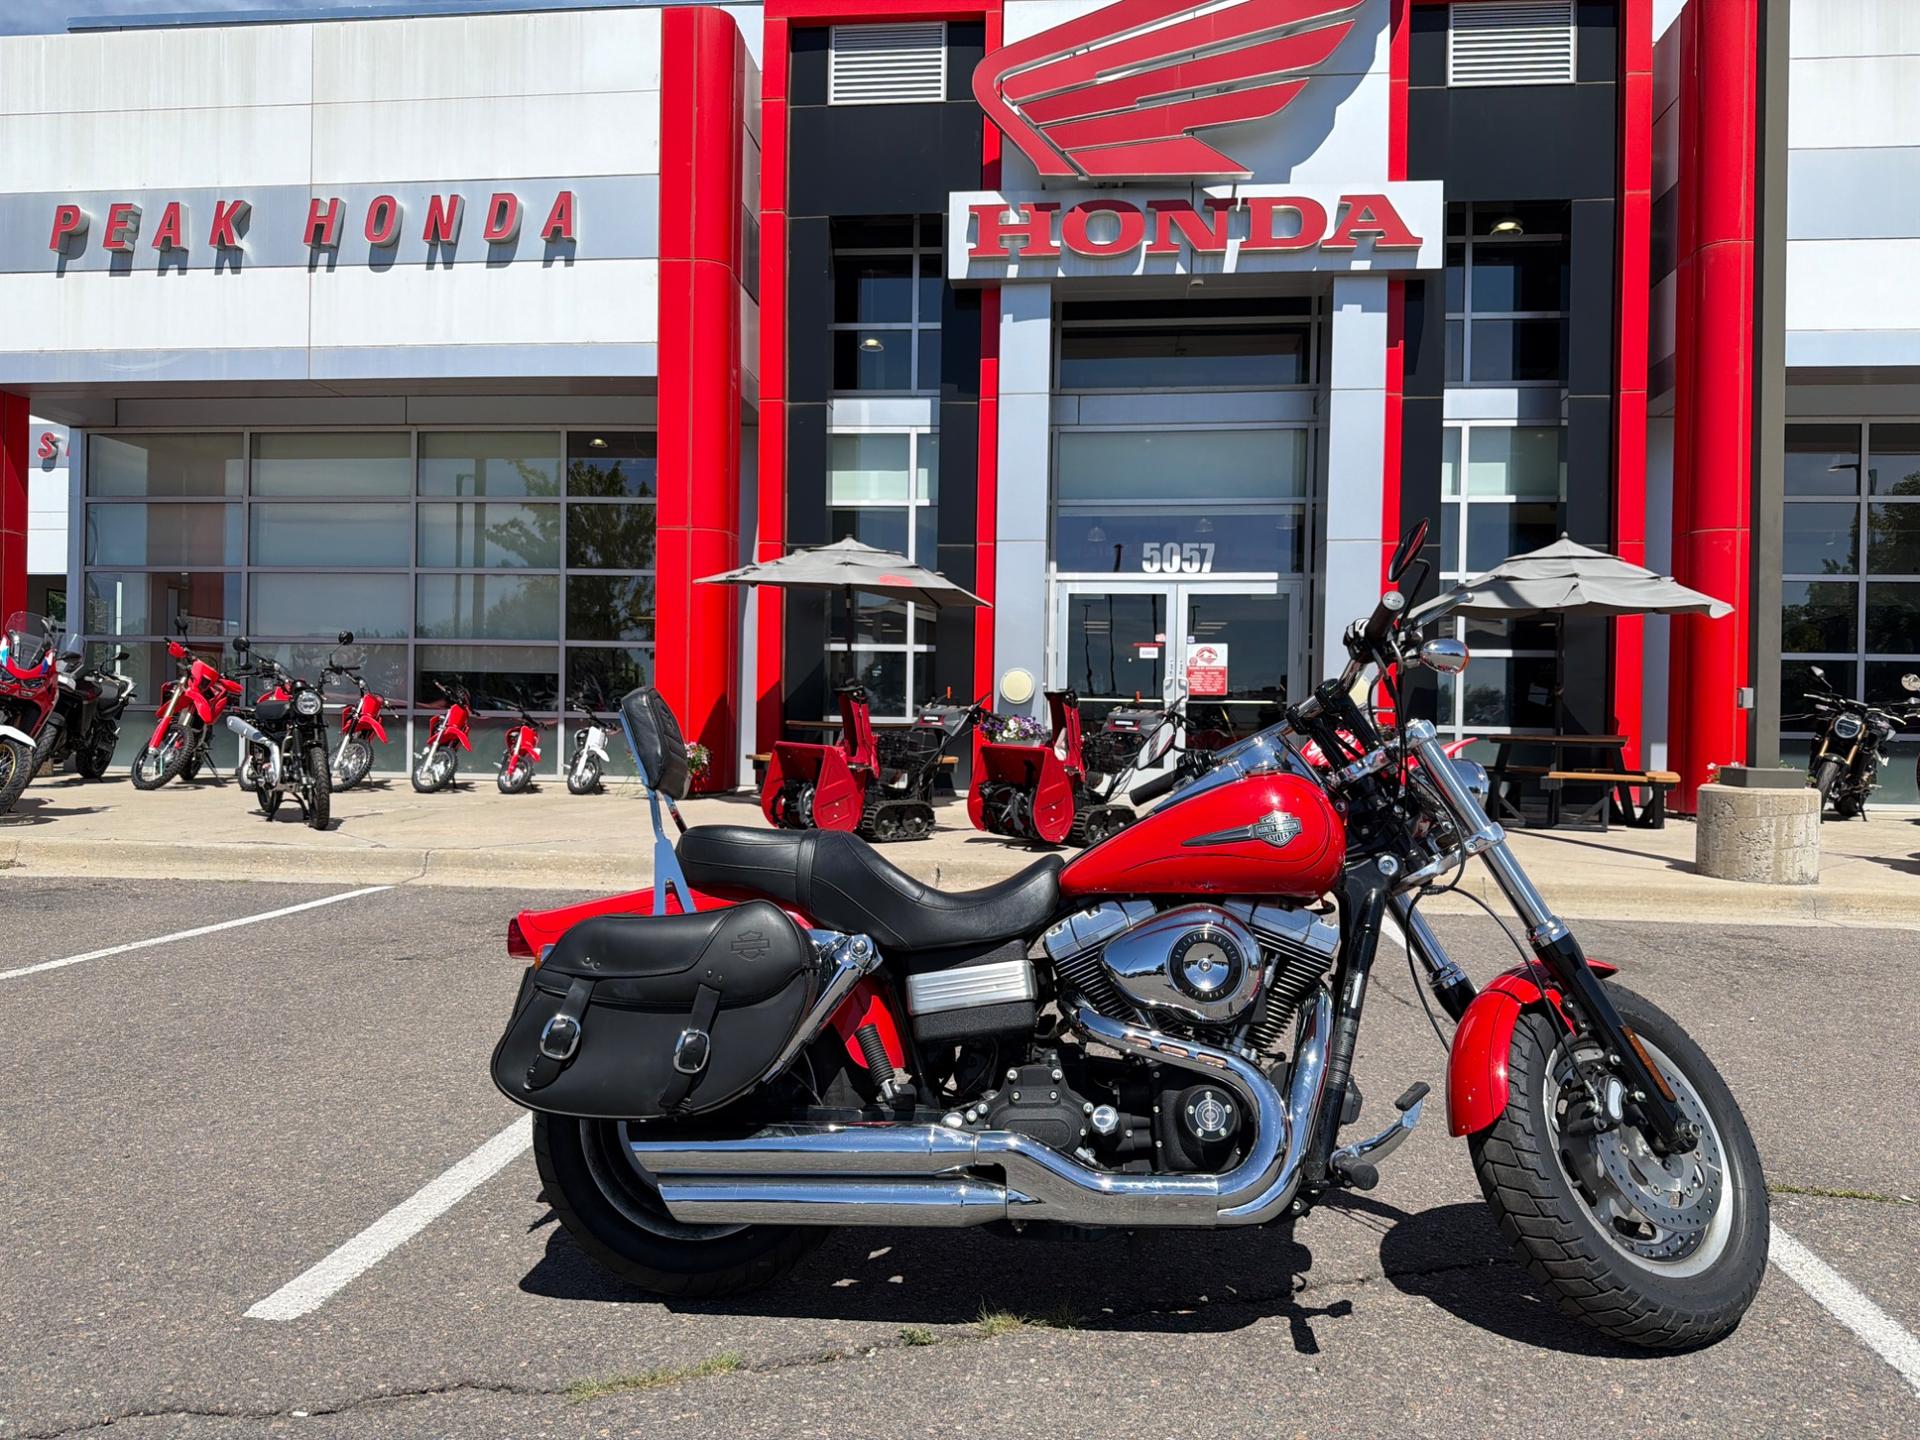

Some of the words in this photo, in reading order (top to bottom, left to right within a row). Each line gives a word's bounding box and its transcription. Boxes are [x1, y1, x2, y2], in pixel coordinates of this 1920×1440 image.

[48, 200, 249, 253] PEAK
[303, 190, 576, 248] HONDA
[967, 194, 1423, 258] HONDA
[1142, 542, 1215, 573] 5057
